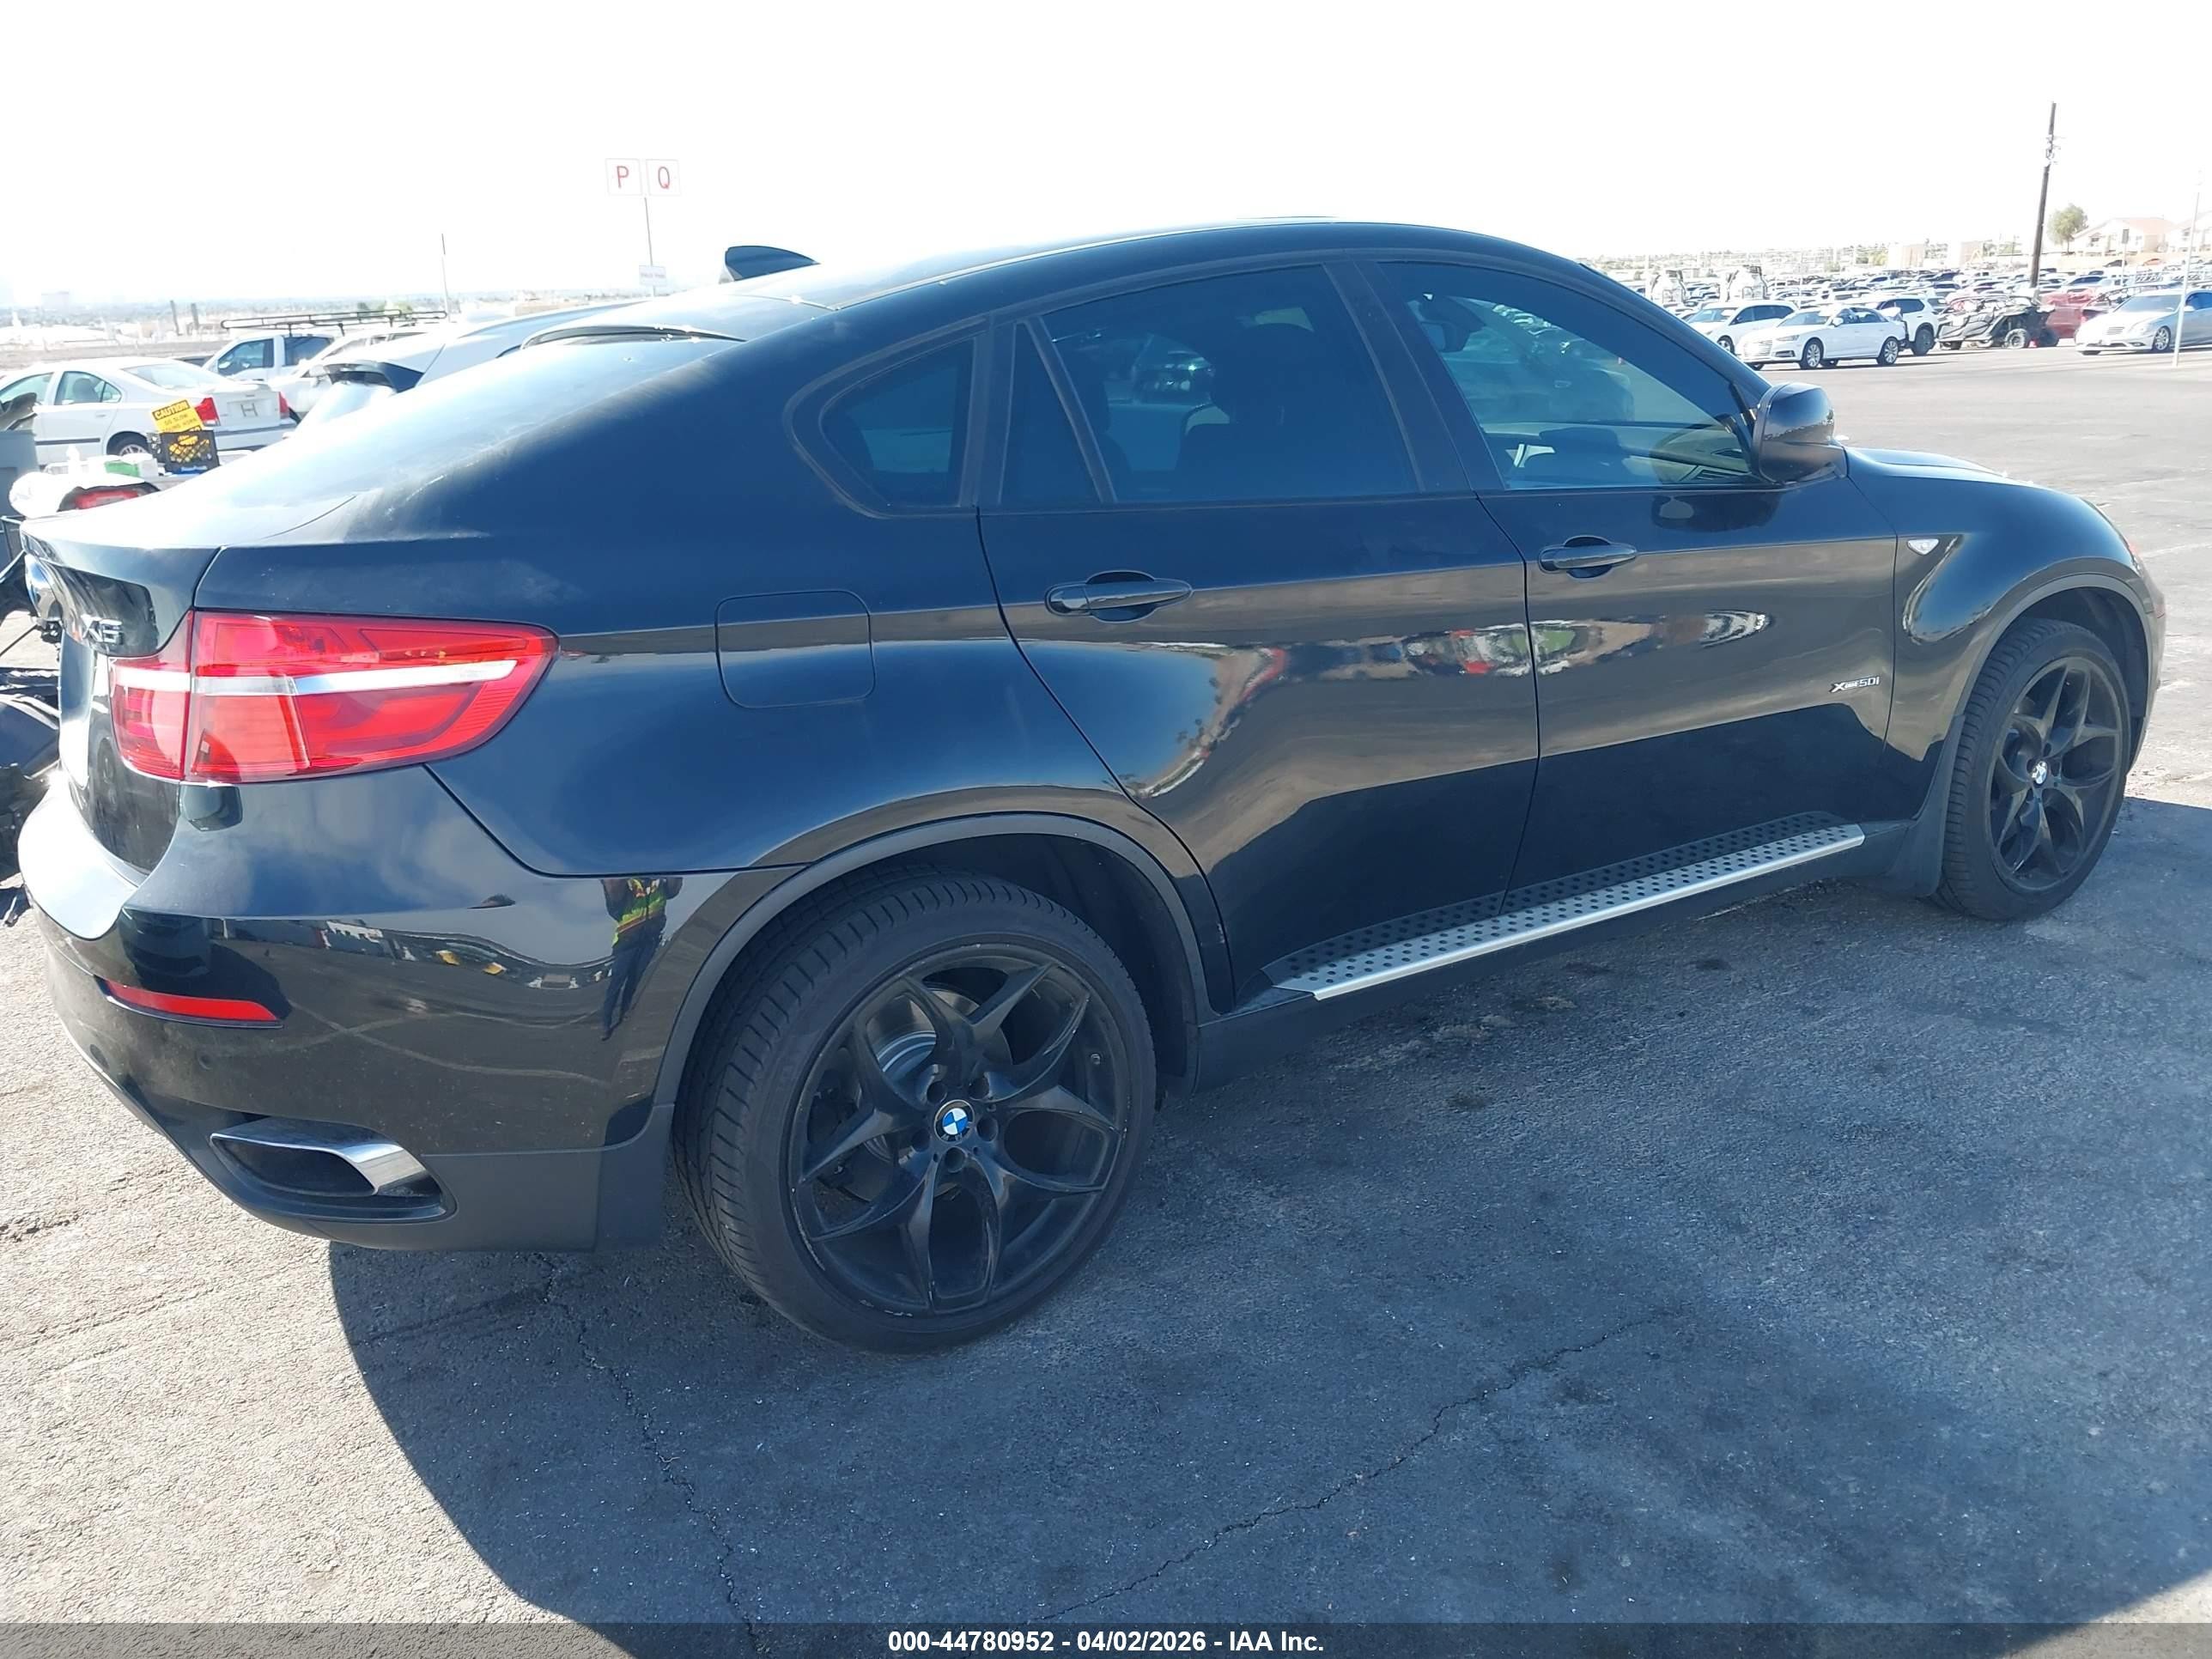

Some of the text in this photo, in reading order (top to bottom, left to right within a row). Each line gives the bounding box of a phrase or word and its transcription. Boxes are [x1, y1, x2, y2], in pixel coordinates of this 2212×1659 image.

[616, 165, 629, 189] P
[658, 166, 671, 190] Q
[155, 401, 190, 419] CAUTION
[240, 402, 259, 418] H
